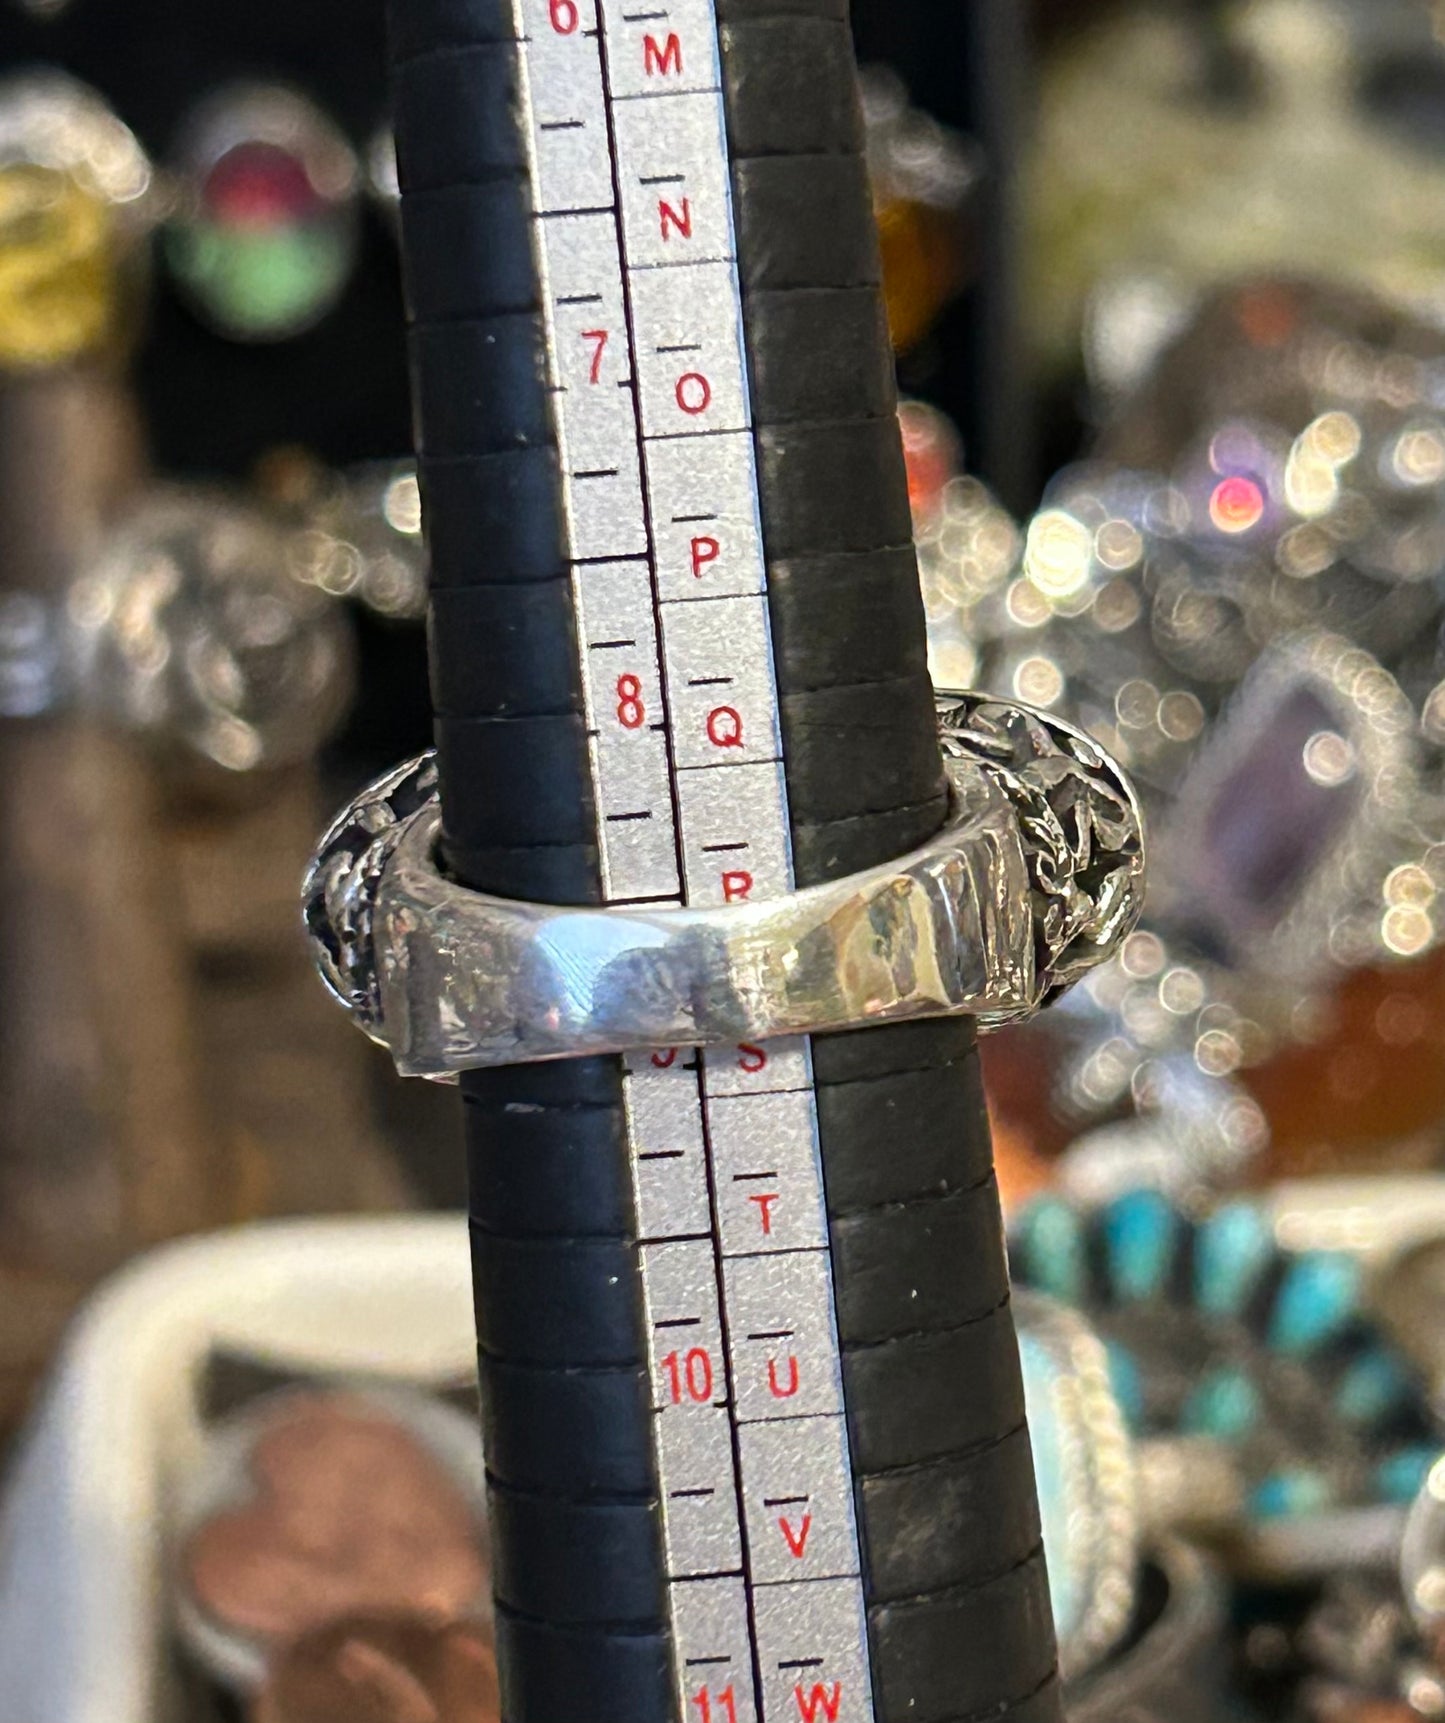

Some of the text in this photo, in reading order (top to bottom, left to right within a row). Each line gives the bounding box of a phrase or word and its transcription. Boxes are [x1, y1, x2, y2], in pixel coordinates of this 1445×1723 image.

[547, 0, 579, 36] 6
[643, 32, 683, 76] M
[658, 197, 693, 242] N
[581, 329, 608, 385] 7
[675, 372, 711, 416] O
[690, 535, 720, 579] P
[615, 672, 645, 729] 8
[705, 705, 744, 748] Q
[721, 870, 754, 901] R
[738, 1043, 767, 1073] S
[749, 1193, 780, 1235] T
[660, 1346, 714, 1405] 10
[768, 1355, 800, 1399] U
[778, 1513, 813, 1559] V
[690, 1682, 737, 1723] 11
[793, 1680, 842, 1723] W
